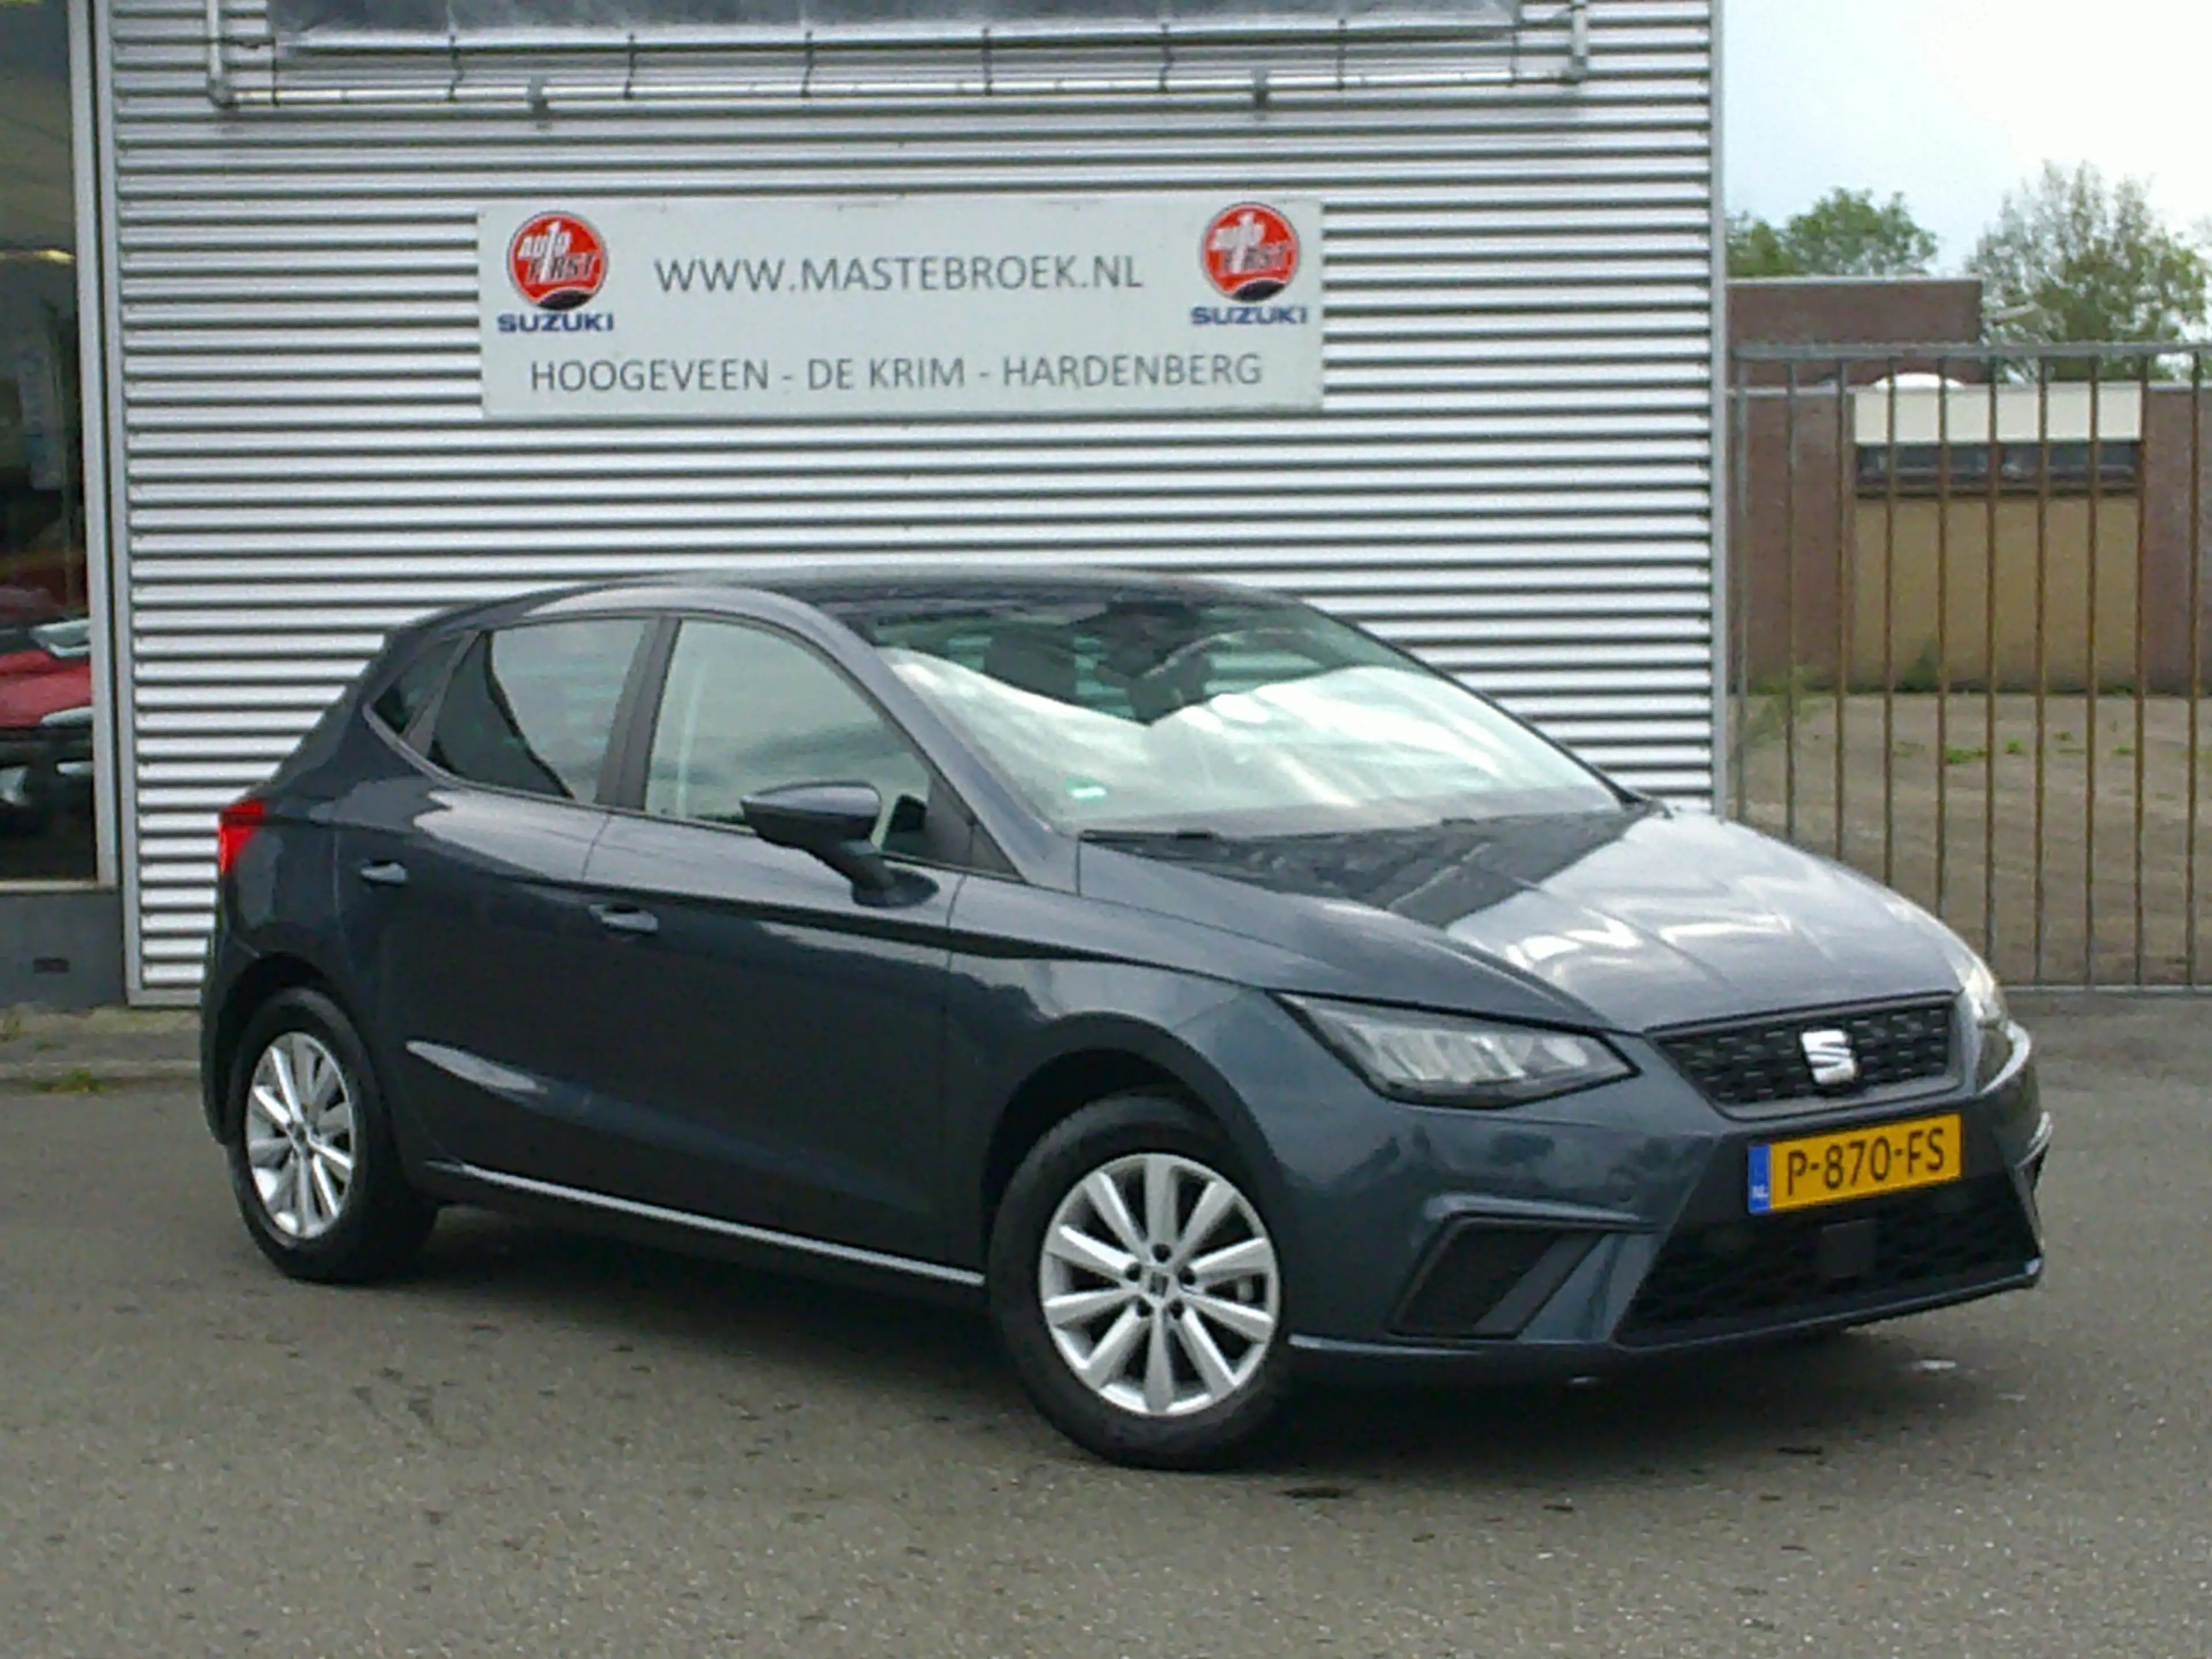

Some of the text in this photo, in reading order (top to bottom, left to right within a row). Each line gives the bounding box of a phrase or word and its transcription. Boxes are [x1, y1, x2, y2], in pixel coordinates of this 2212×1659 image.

[654, 255, 1143, 293] WWW.MASTEBROEK.NL
[497, 314, 614, 332] SUZUKI
[1192, 306, 1307, 324] SUZUKI
[531, 359, 768, 392] HOOGEVEEN
[808, 358, 852, 390] DE
[869, 358, 964, 388] KRIM
[1004, 353, 1262, 387] HARDENBERG
[1787, 1128, 1944, 1196] P-870-FS
